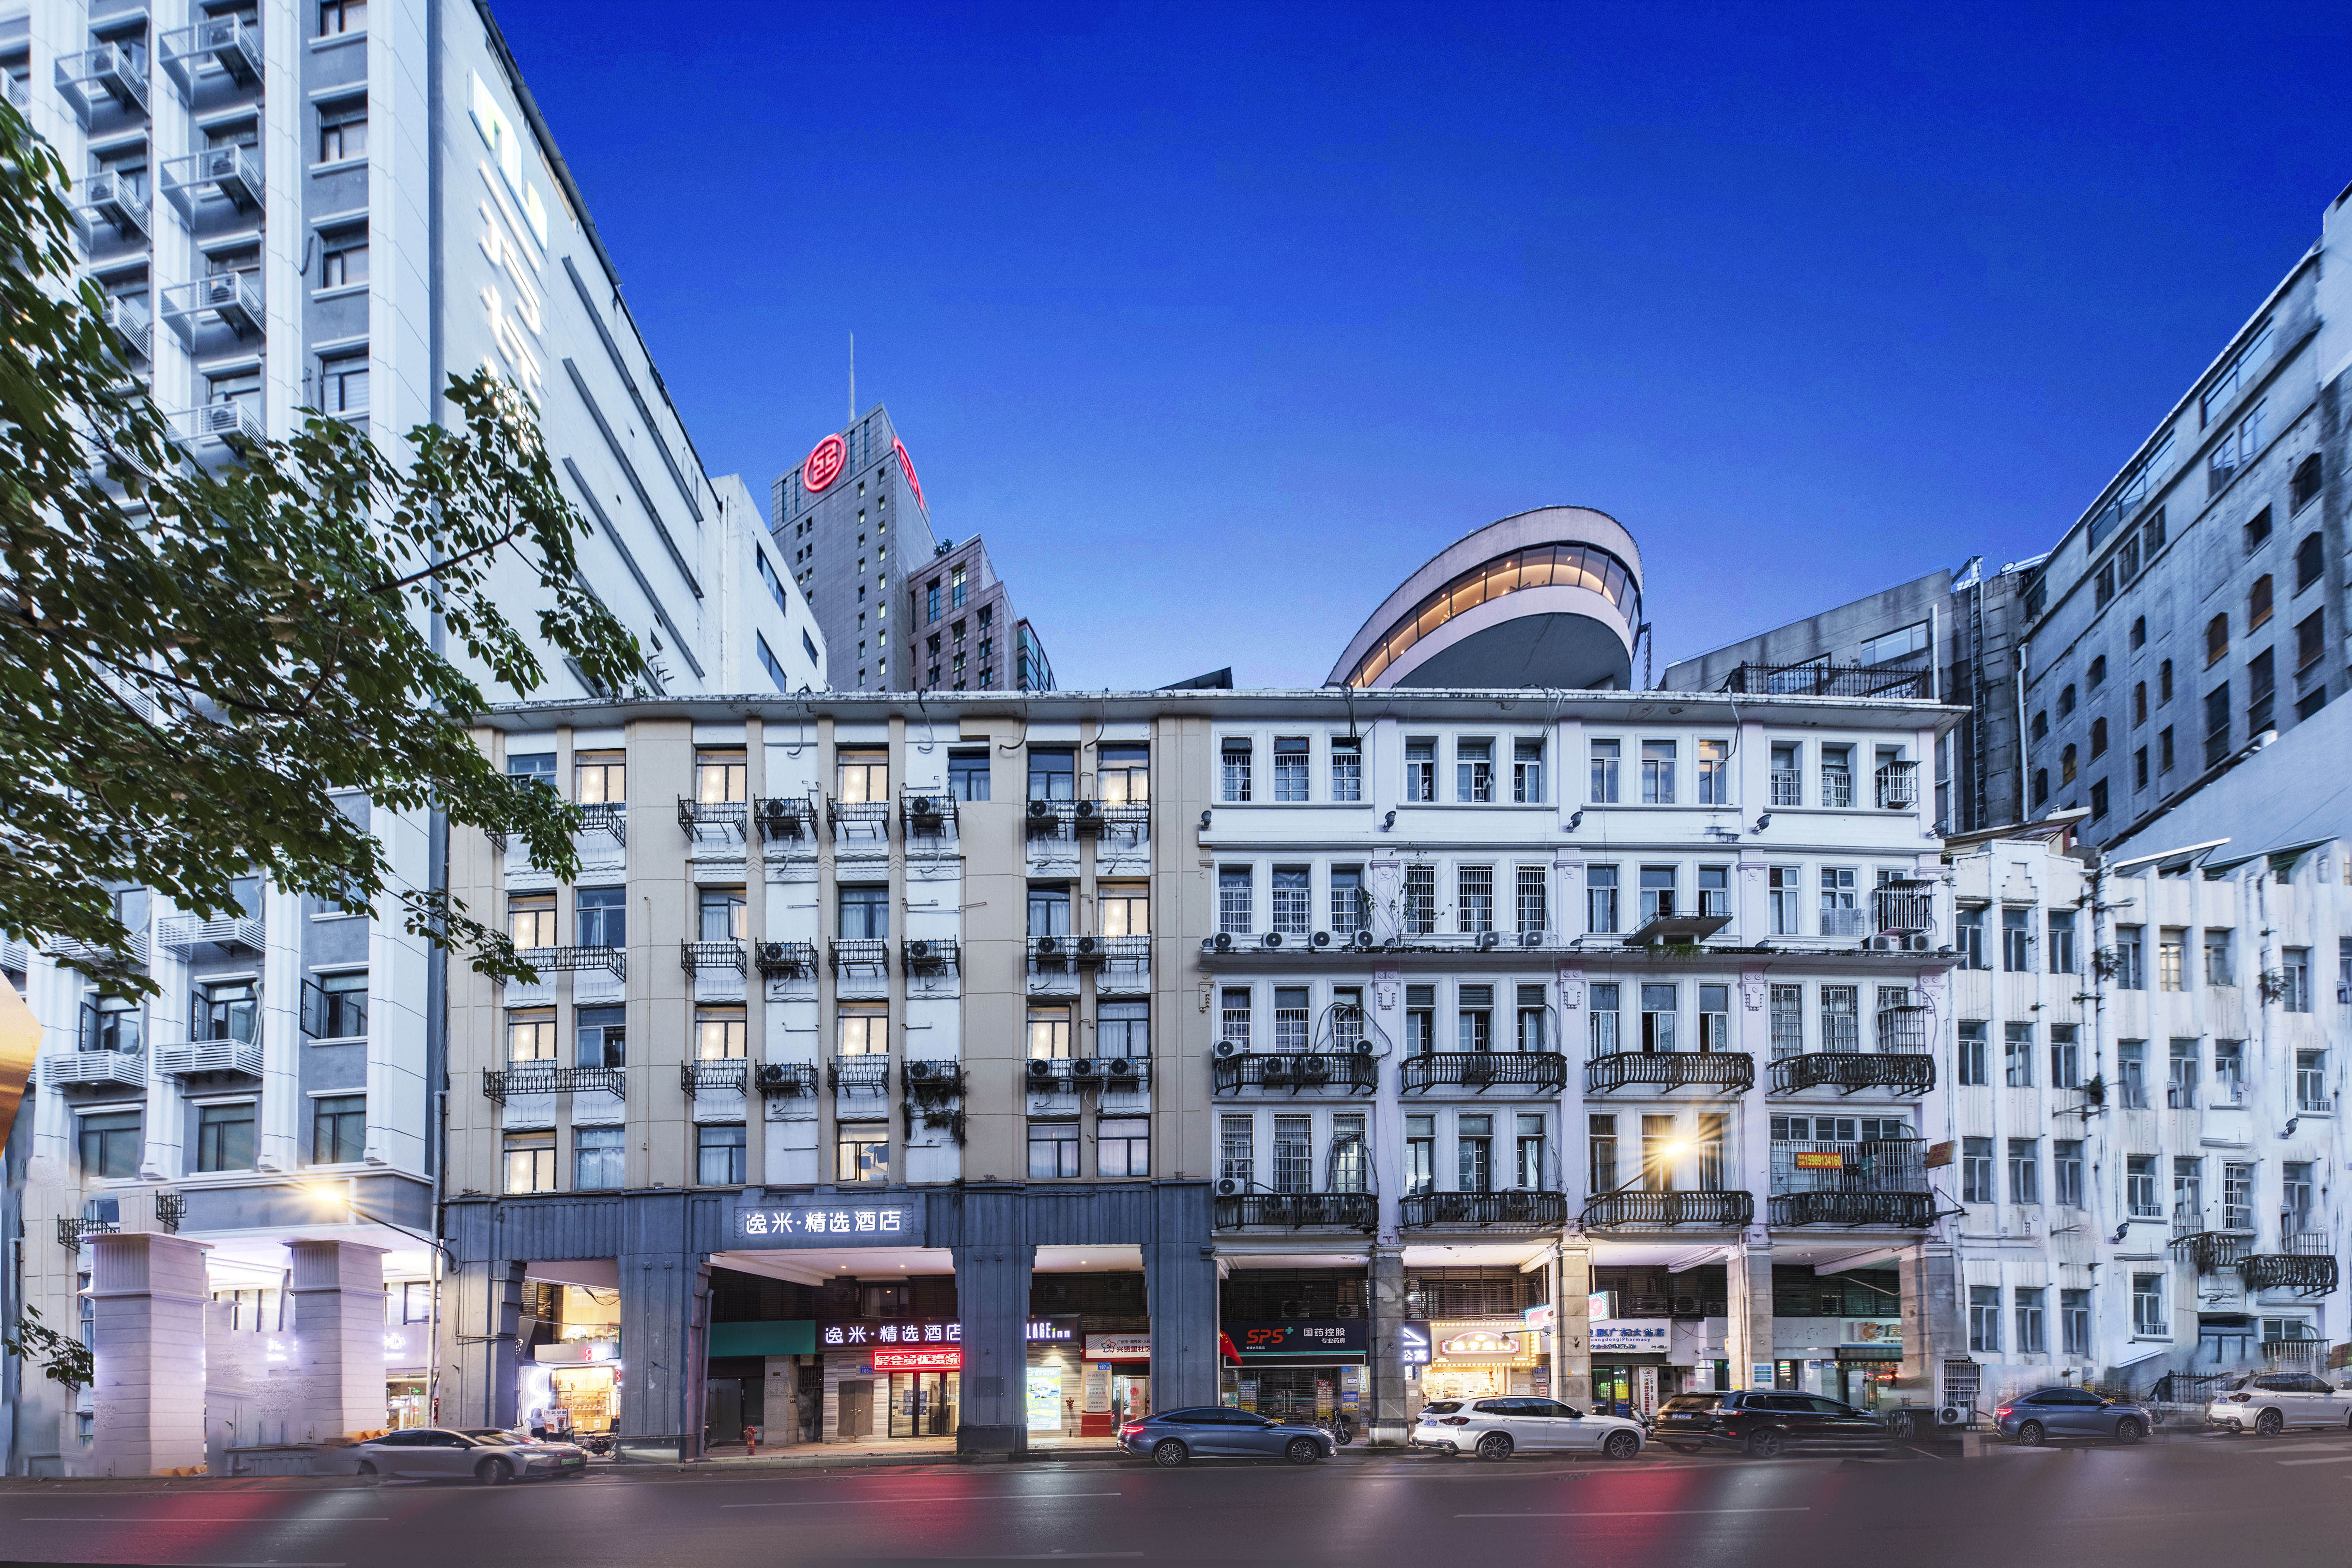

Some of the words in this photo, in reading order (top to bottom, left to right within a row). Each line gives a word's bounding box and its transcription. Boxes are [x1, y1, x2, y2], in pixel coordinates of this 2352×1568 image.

[1805, 1155, 1841, 1166] 15989134160
[746, 1210, 901, 1234] 逸米·精选酒店
[826, 1324, 960, 1344] 逸米·精选酒店
[1304, 1328, 1345, 1337] 国药控股
